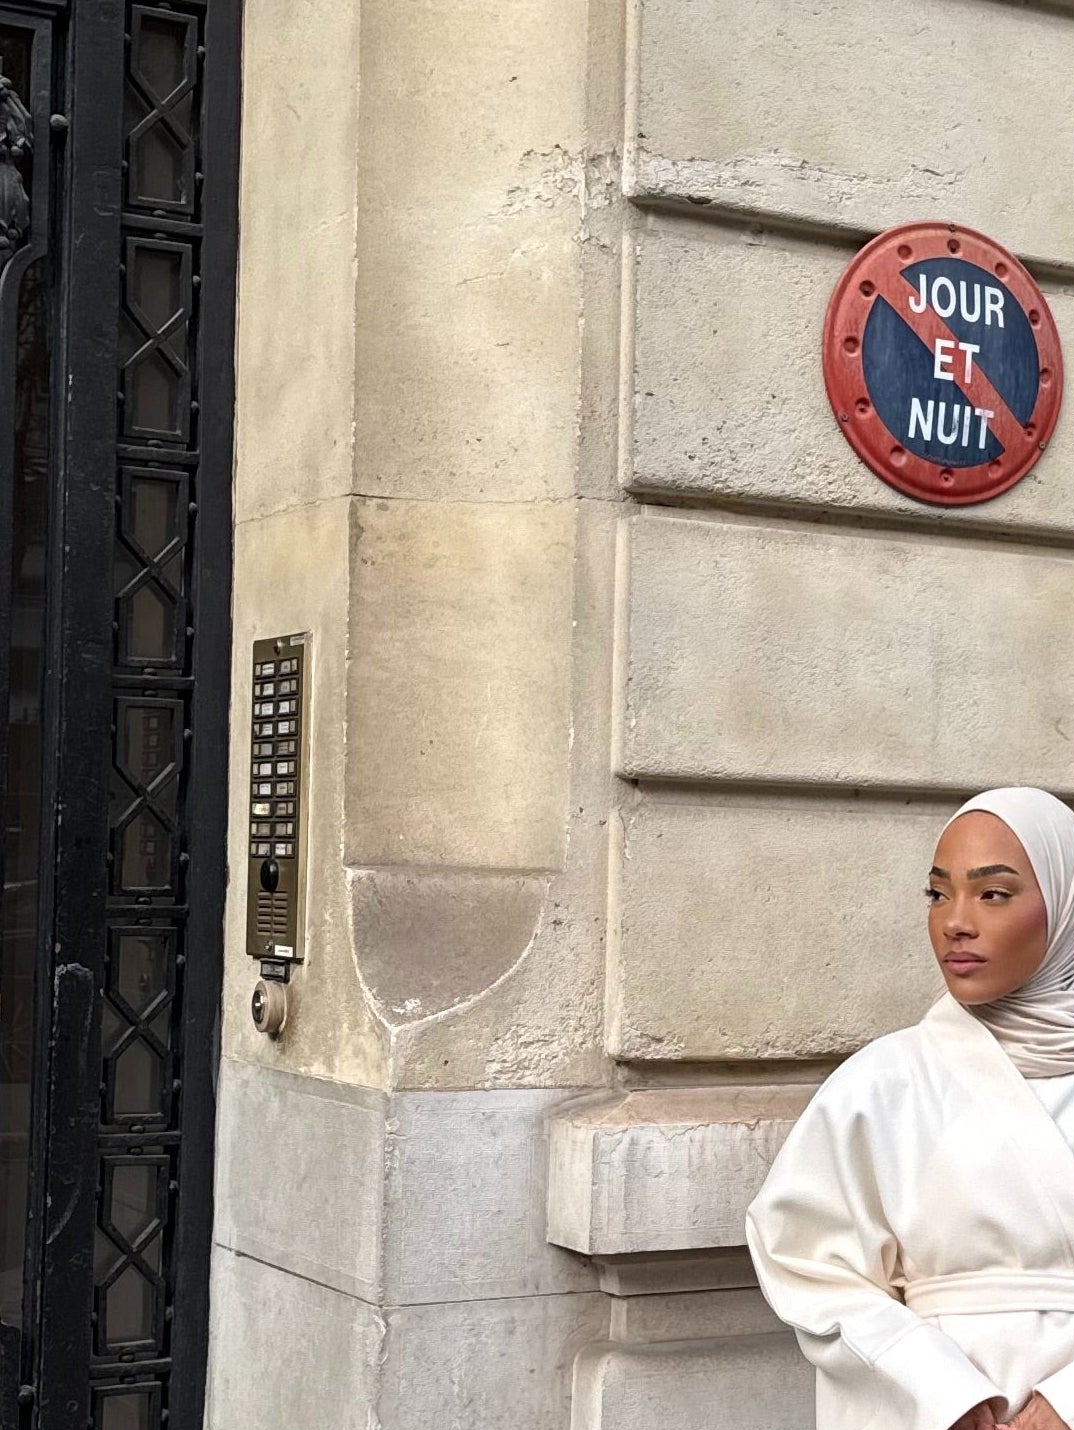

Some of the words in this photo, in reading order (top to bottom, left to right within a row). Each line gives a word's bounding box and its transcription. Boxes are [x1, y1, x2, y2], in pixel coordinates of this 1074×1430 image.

[908, 273, 1005, 328] JOUR
[934, 338, 980, 384] ET
[908, 397, 995, 449] NUIT
